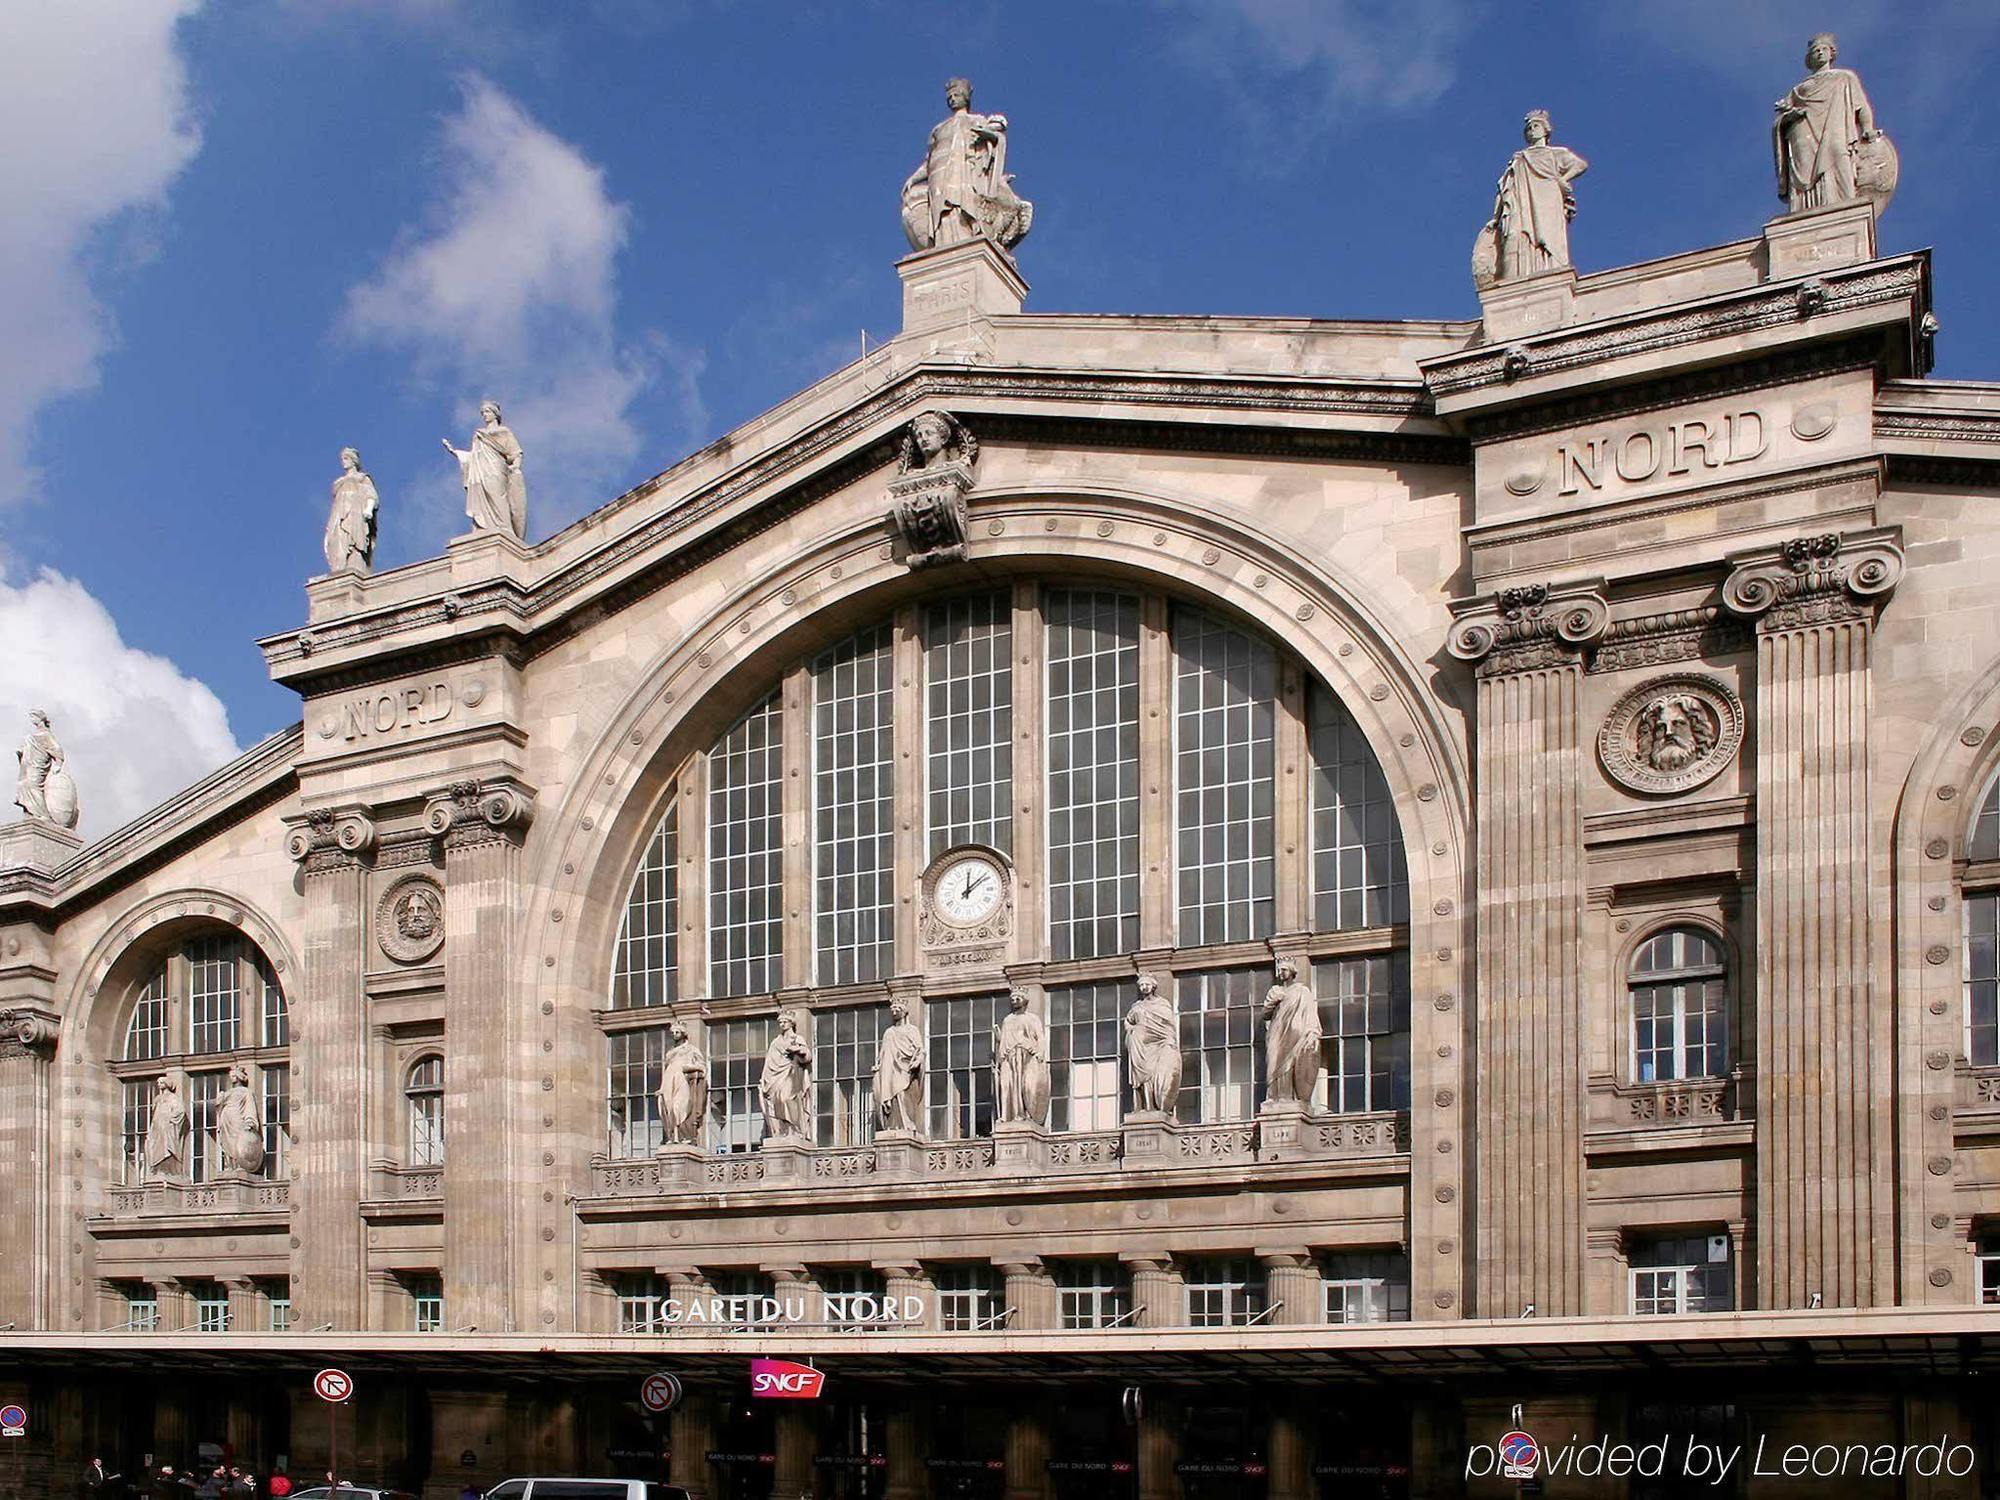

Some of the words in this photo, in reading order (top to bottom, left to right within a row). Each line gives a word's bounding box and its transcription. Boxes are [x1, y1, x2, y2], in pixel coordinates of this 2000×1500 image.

[1557, 410, 1769, 497] NORD
[344, 684, 454, 741] NORD
[660, 1299, 744, 1323] GARE
[762, 1298, 804, 1322] DU
[824, 1296, 925, 1322] NORD
[753, 1373, 817, 1392] SNCF
